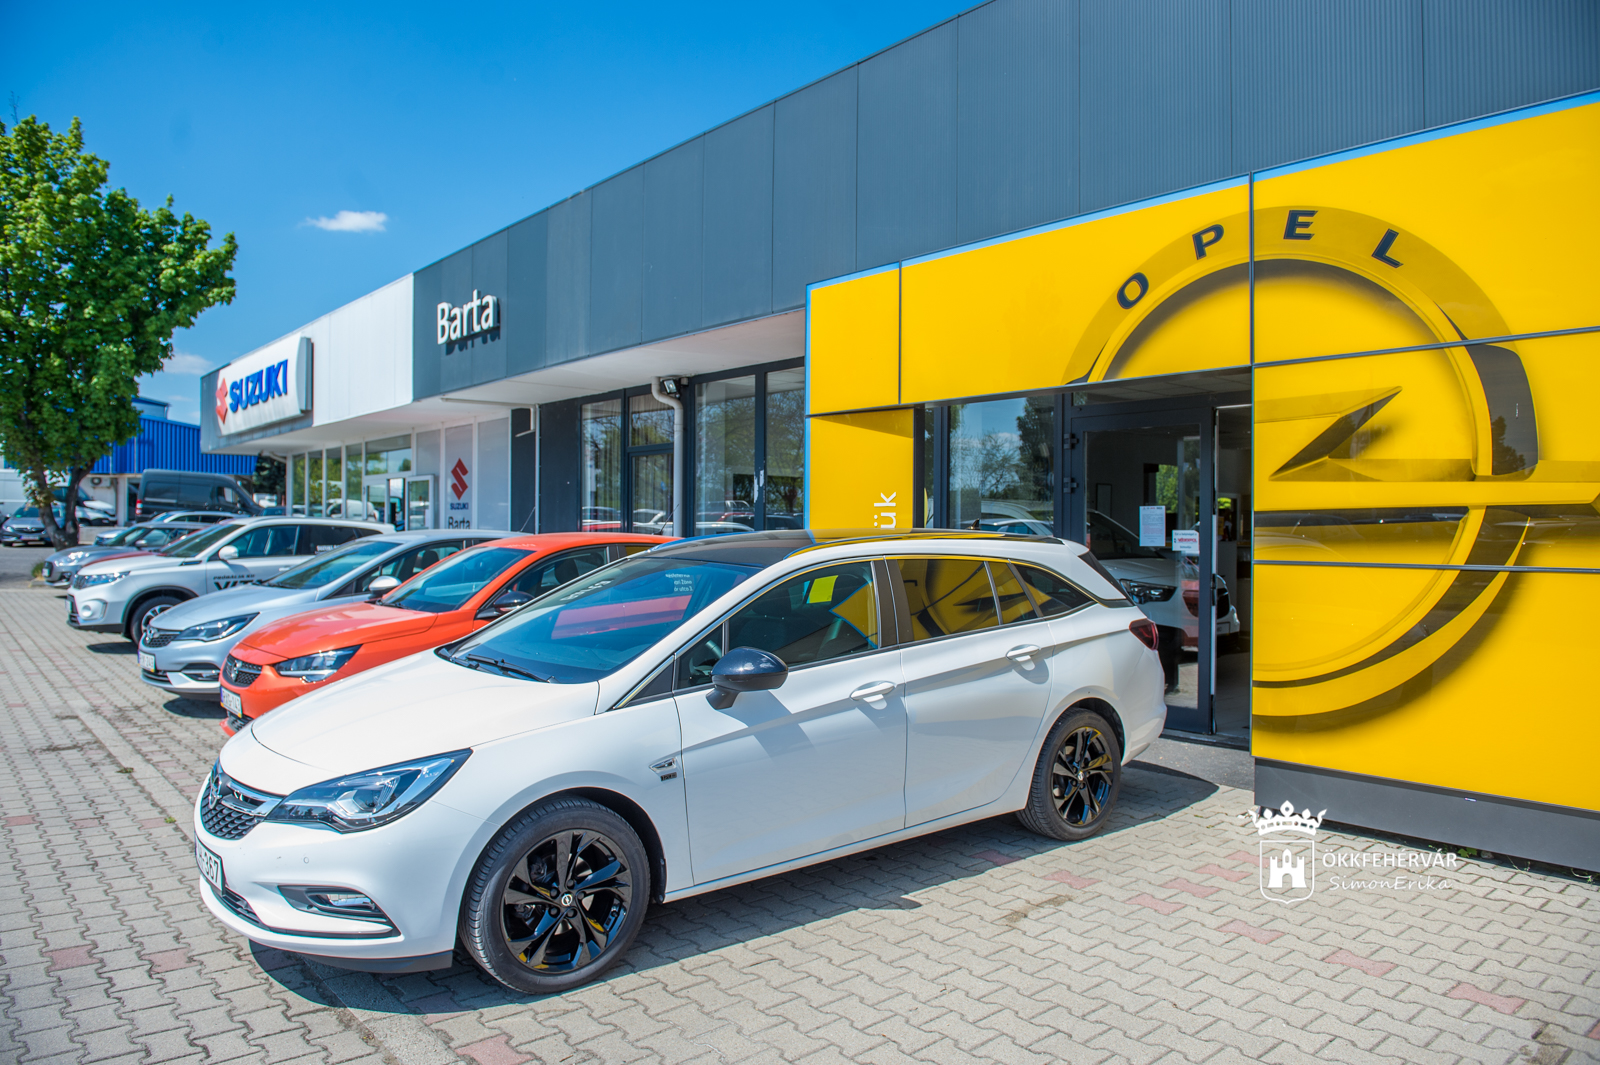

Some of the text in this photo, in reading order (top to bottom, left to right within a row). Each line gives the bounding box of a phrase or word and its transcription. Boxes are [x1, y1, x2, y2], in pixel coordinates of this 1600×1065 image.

[1117, 209, 1403, 310] OPEL
[437, 289, 498, 345] Barta
[229, 359, 288, 413] SUZUKI
[449, 502, 469, 511] SUZUKI
